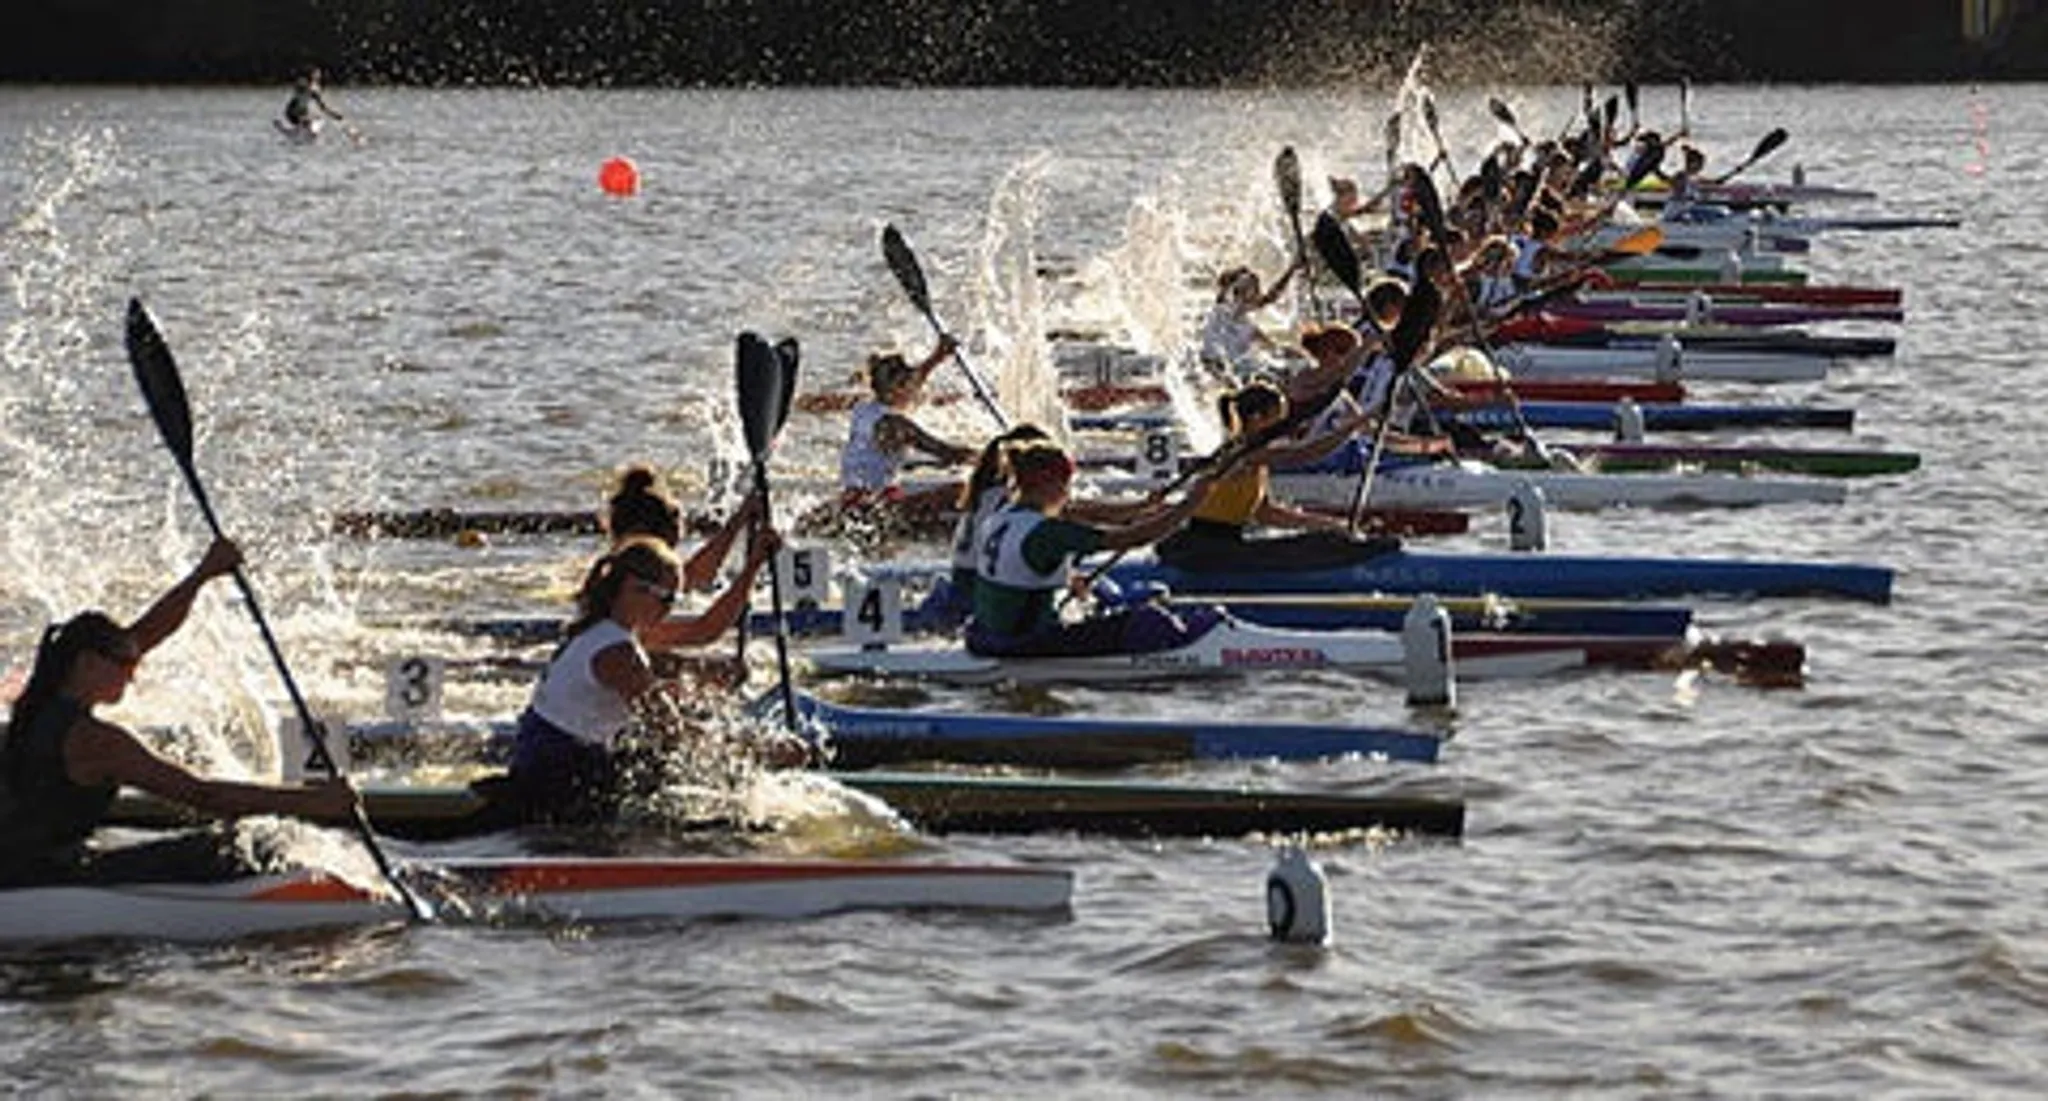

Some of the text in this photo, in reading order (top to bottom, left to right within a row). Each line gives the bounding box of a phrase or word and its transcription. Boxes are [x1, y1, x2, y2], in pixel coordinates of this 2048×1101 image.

[1147, 434, 1170, 464] 8
[794, 550, 812, 590] 5
[984, 521, 1010, 577] 4
[858, 588, 884, 633] 4
[401, 658, 430, 708] 3
